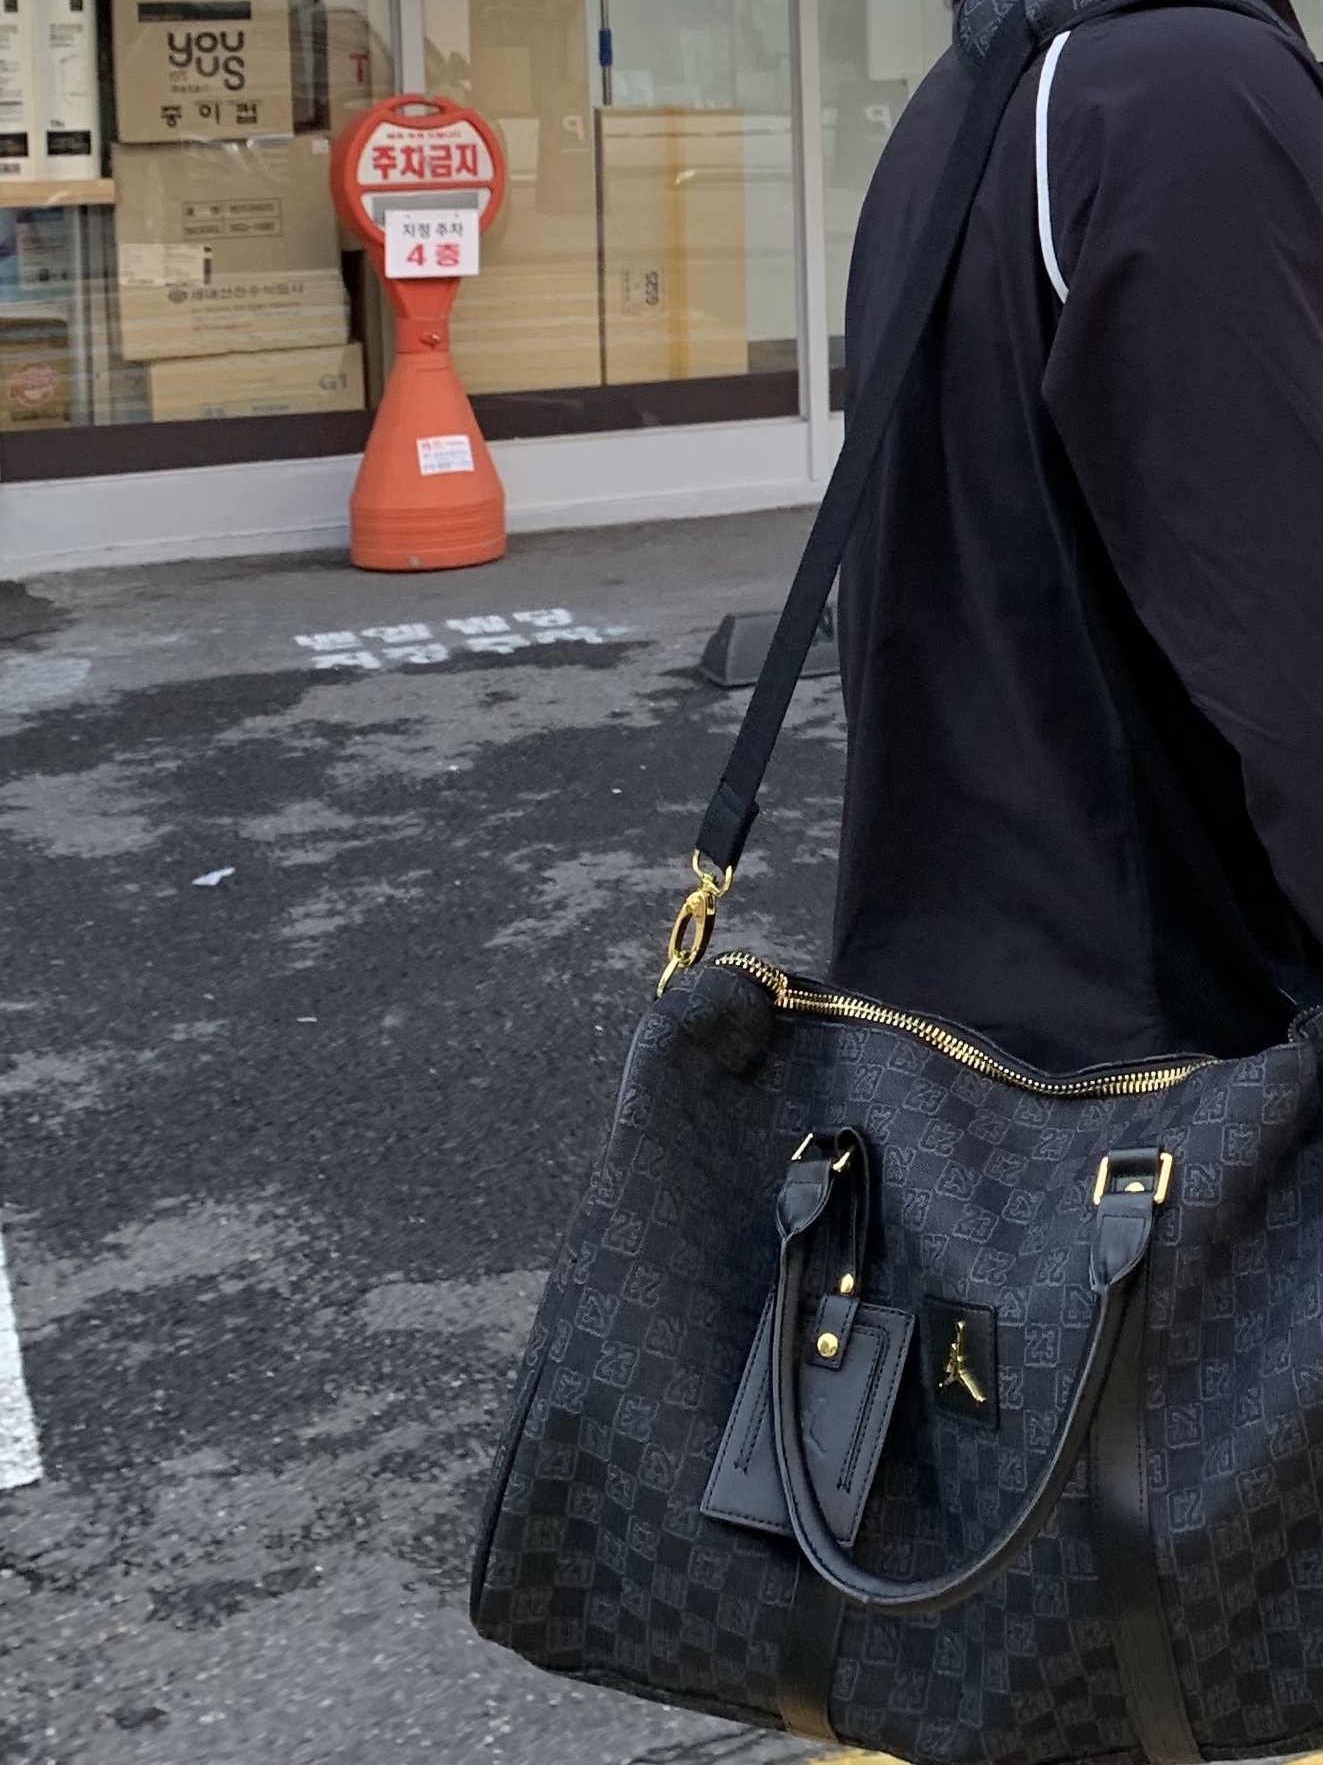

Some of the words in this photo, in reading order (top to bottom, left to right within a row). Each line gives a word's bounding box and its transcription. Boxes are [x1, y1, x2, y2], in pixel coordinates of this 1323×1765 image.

[372, 143, 478, 180] 주차금지
[402, 222, 430, 239] 지정
[435, 222, 463, 238] 주차
[407, 243, 426, 266] 4
